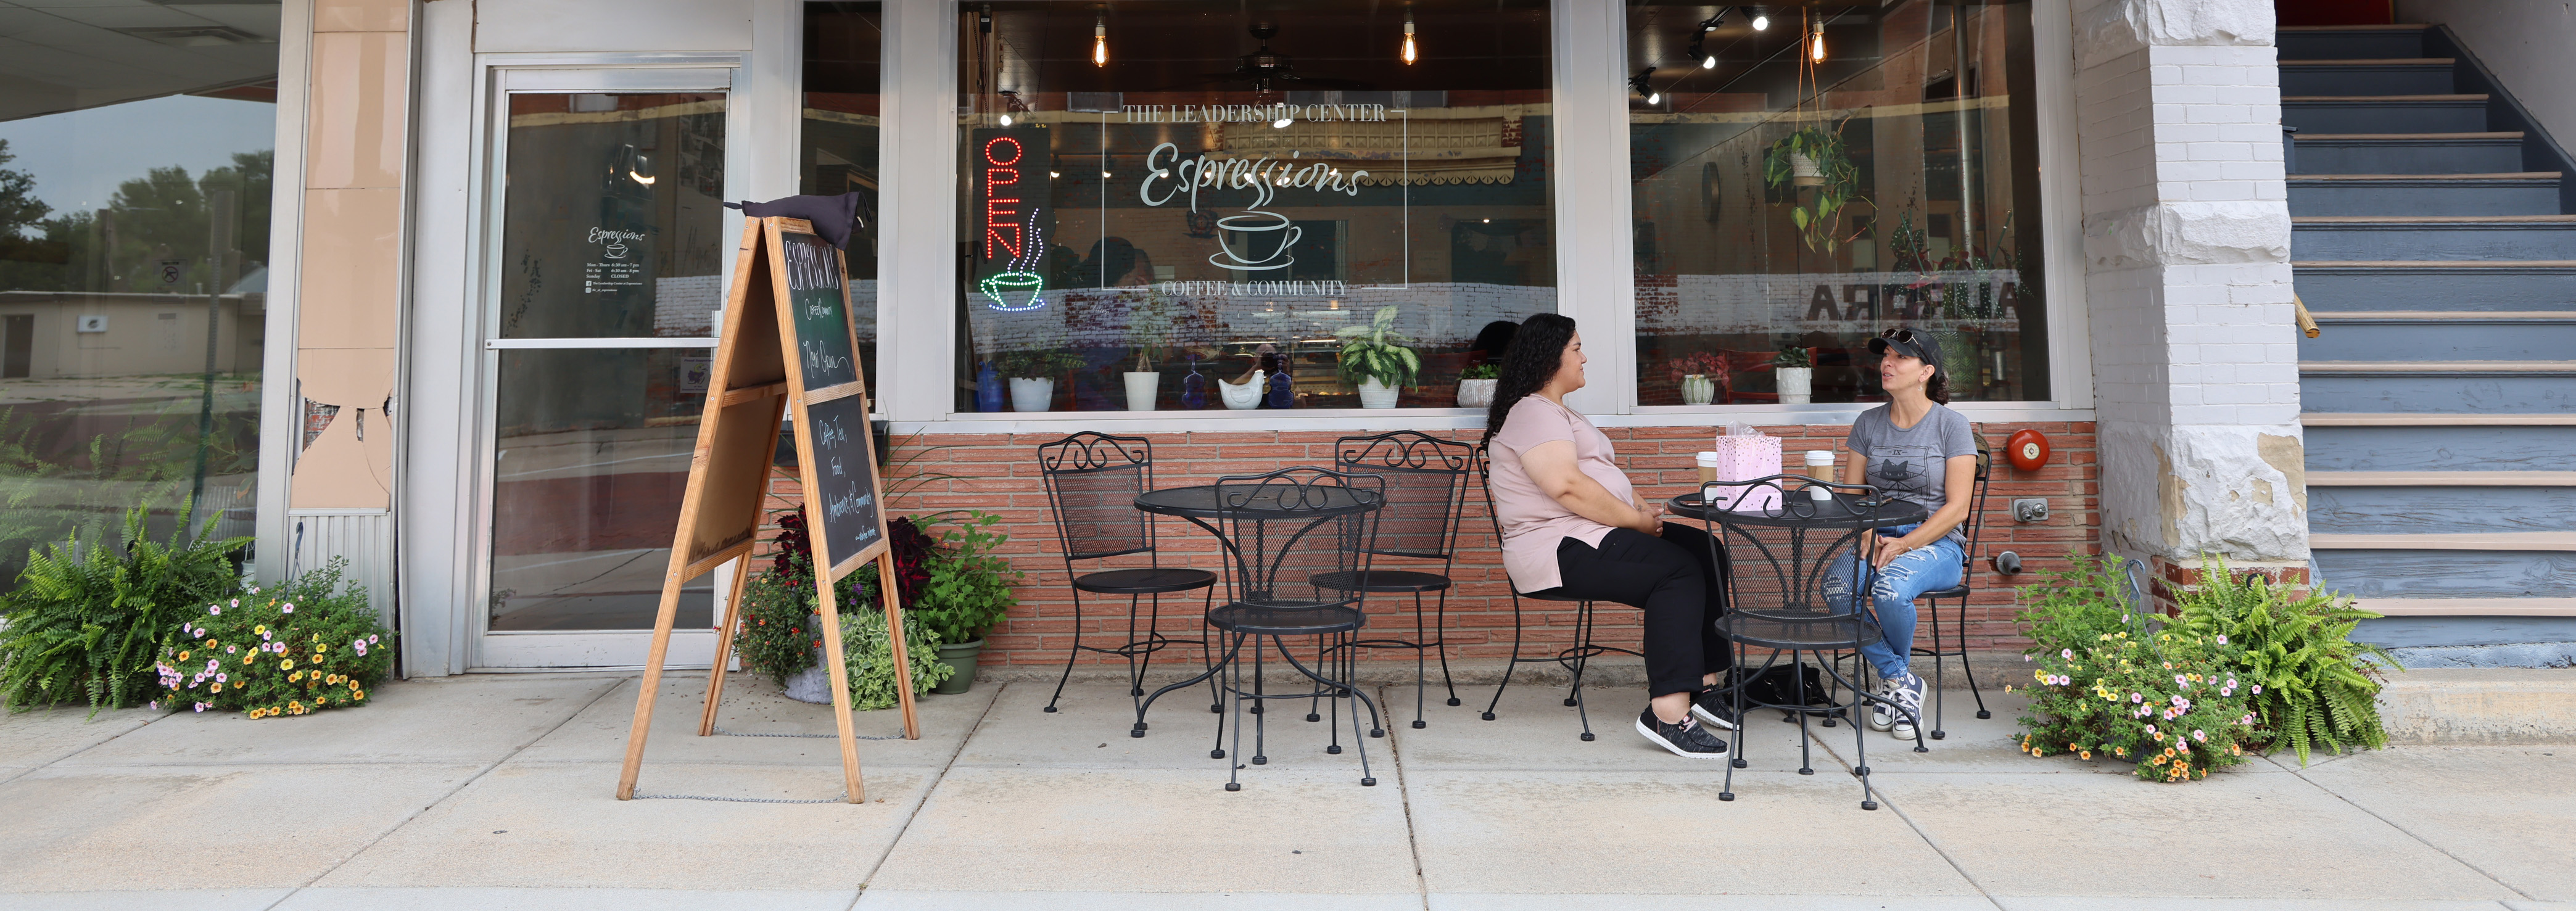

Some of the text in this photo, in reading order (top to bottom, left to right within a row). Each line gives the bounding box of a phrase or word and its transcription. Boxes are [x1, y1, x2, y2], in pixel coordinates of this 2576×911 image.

[1123, 104, 1386, 123] THE LEADERSHIP CENTER
[1140, 142, 1369, 214] Espressions
[985, 137, 1022, 258] OPEN
[588, 226, 645, 245] Espressions
[1162, 279, 1348, 297] COFFEE & COMMUNITY
[803, 340, 850, 379] Now Open
